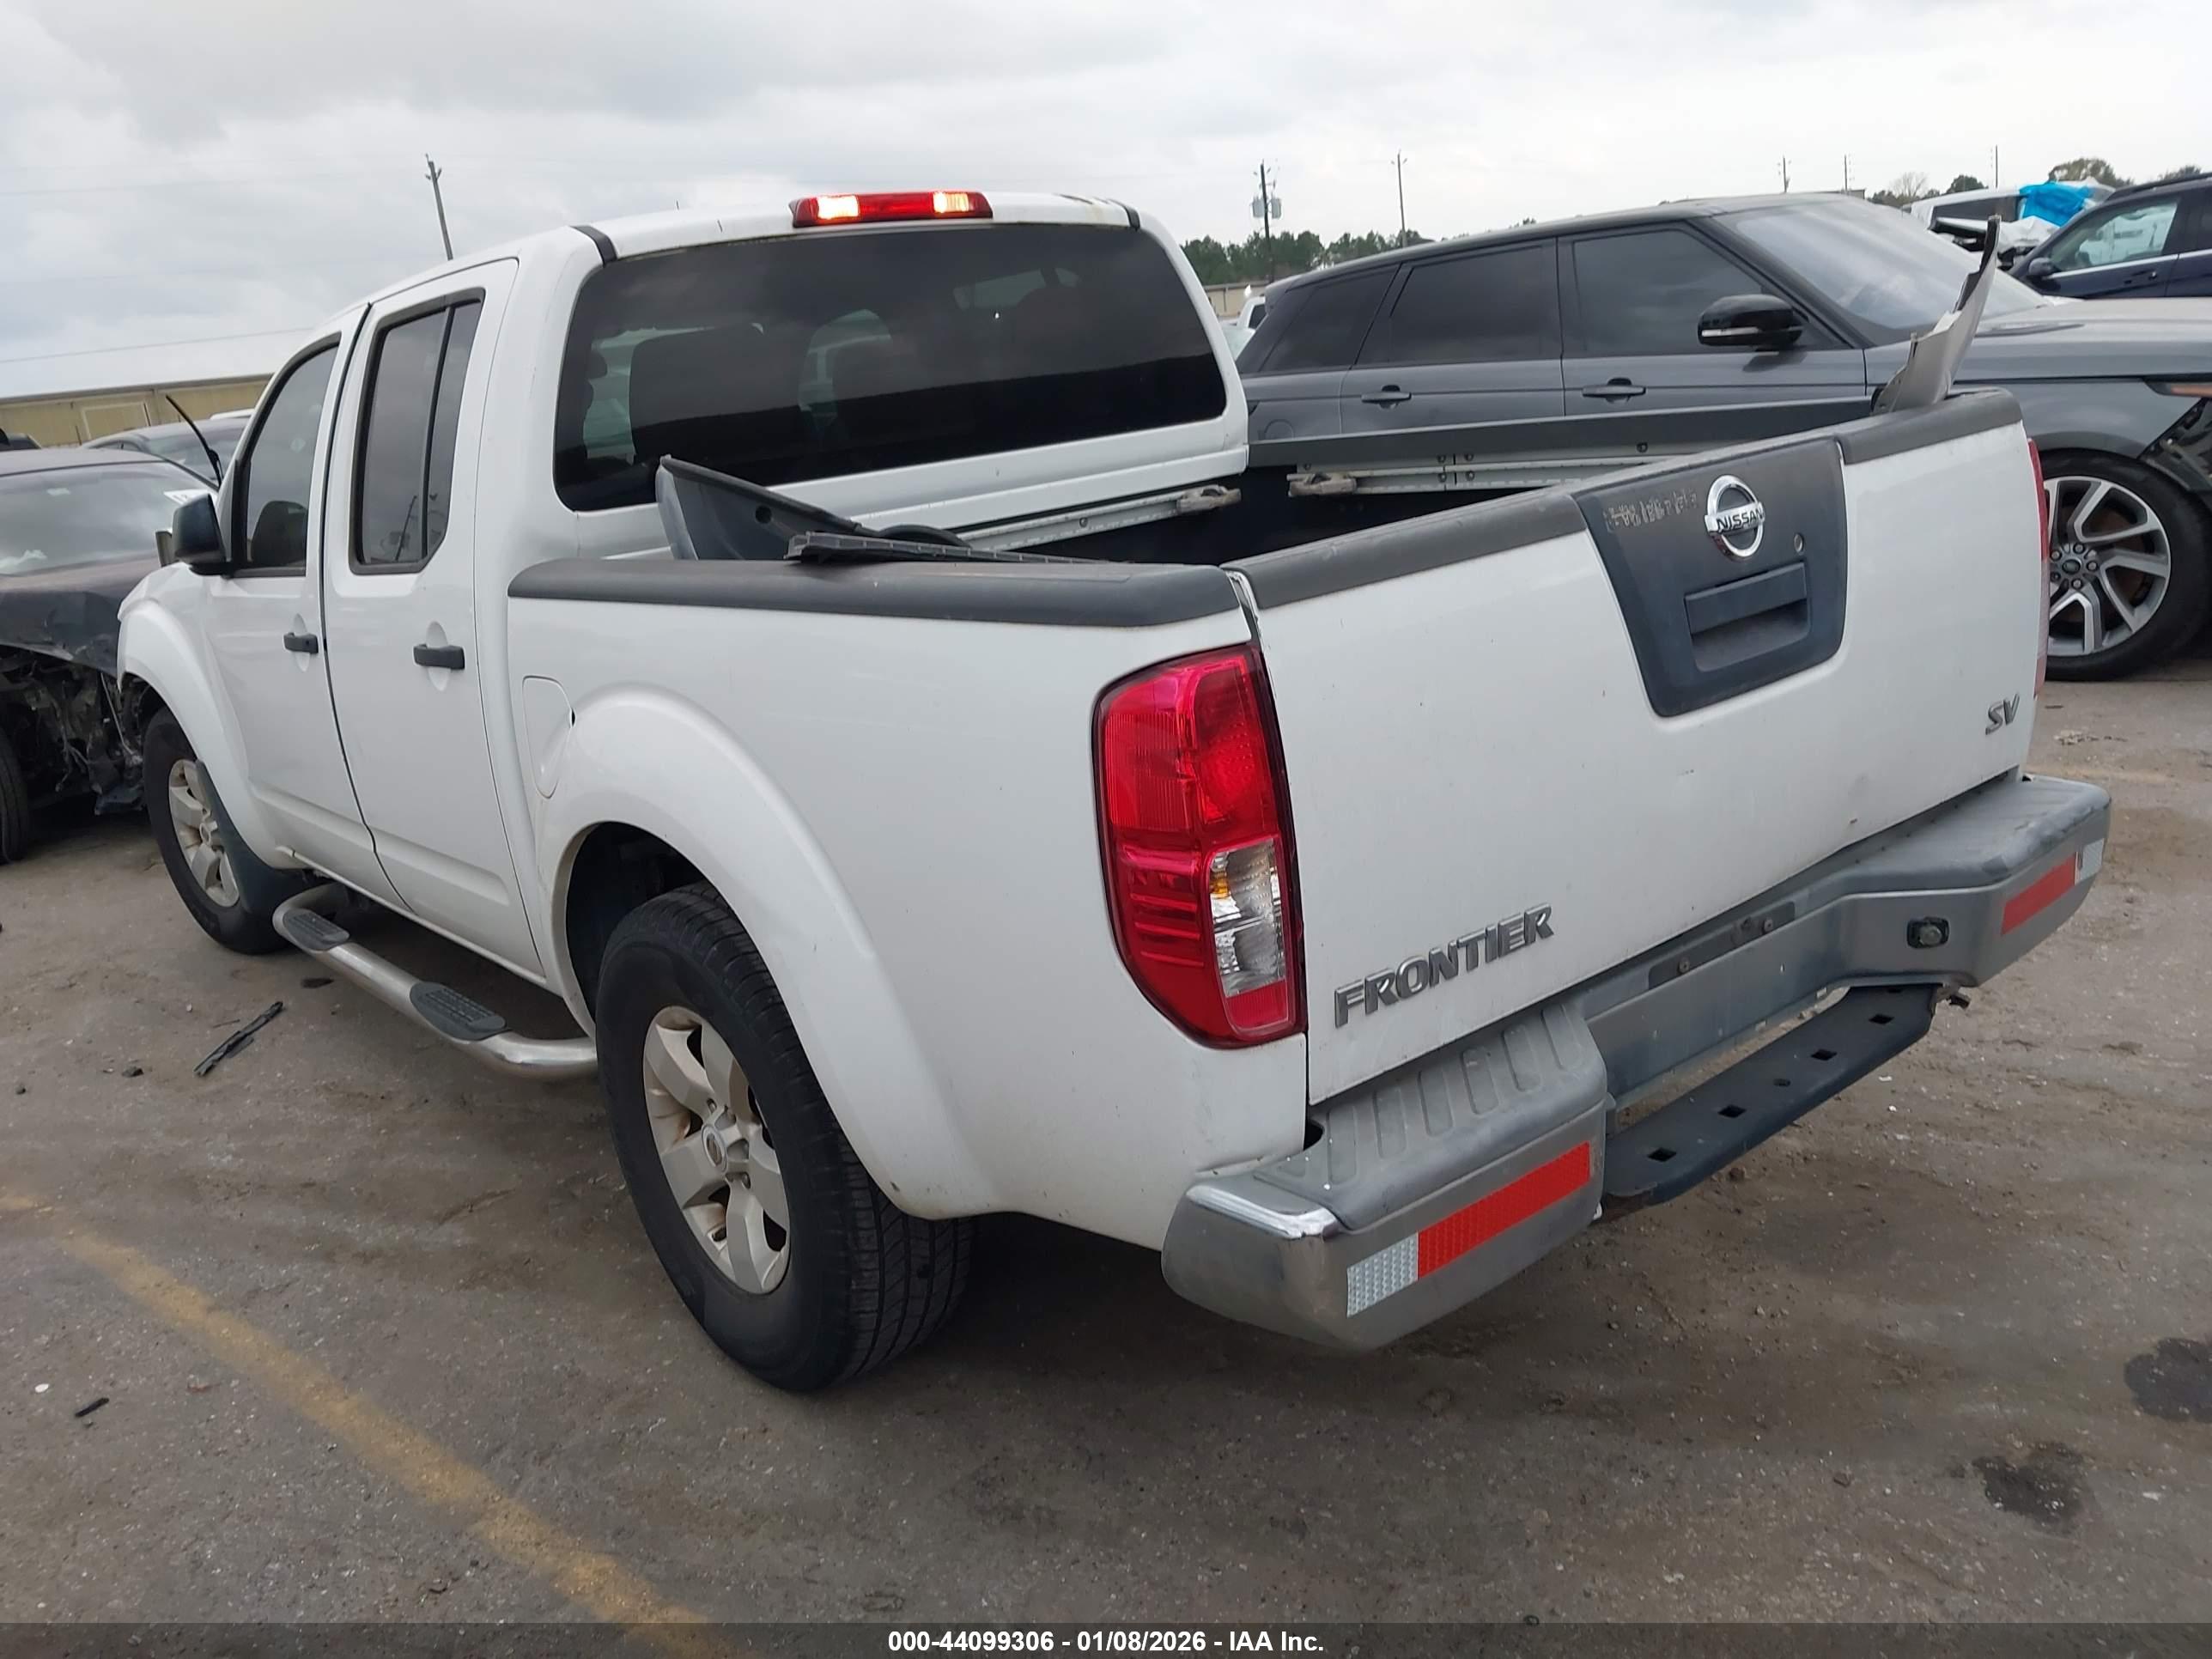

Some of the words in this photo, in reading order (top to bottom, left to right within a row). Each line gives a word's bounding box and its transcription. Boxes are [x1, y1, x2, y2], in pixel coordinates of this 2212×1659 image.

[1717, 507, 1764, 532] NISSAN
[1985, 693, 2020, 735] SV
[1334, 902, 1554, 1029] FRONTIER
